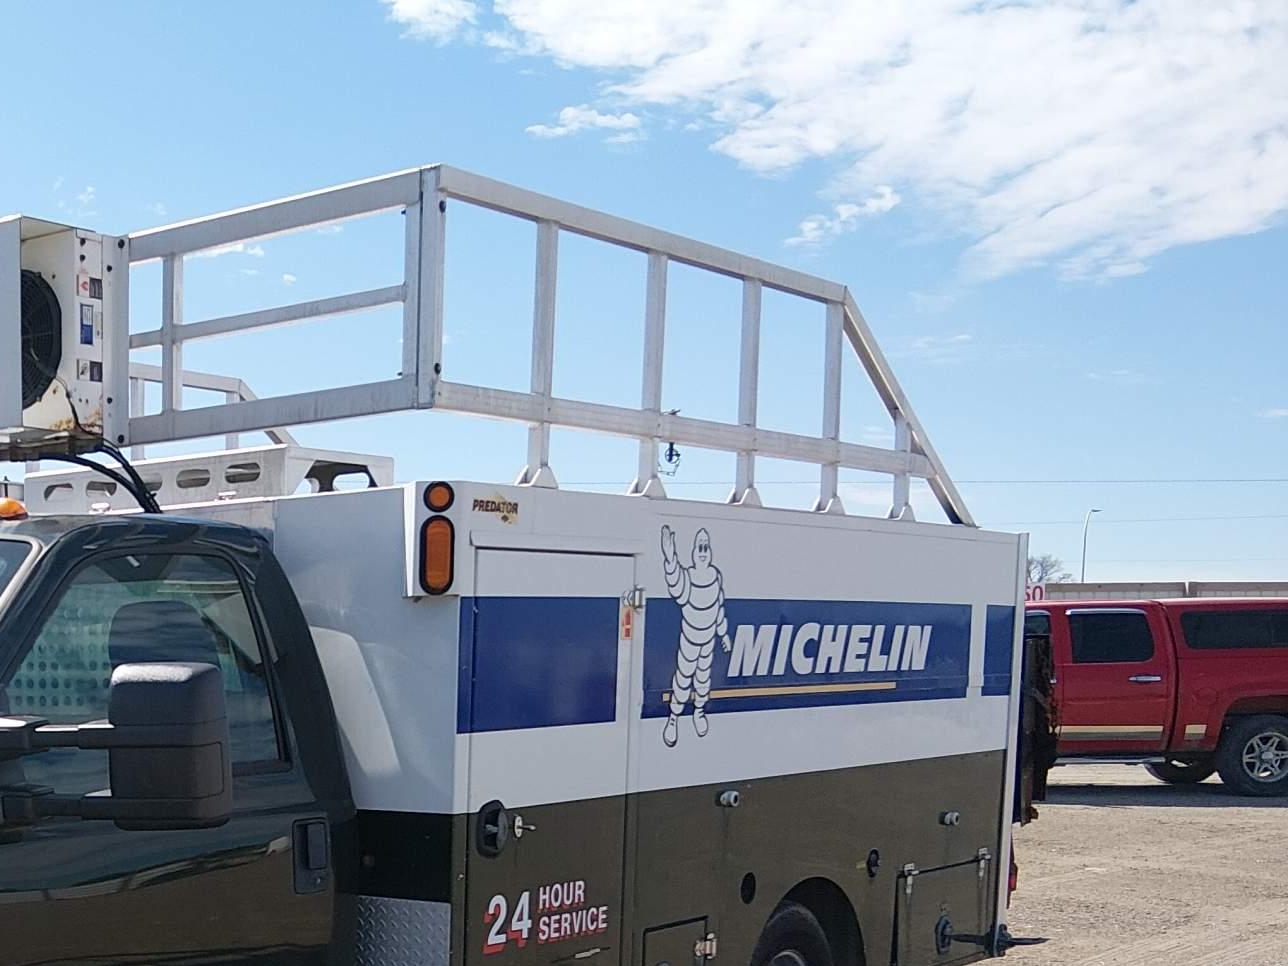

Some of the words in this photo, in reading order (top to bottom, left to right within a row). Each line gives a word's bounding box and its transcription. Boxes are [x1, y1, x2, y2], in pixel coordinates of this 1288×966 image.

[472, 498, 519, 514] PREDATOR
[727, 622, 932, 678] MICHELIN
[538, 880, 585, 911] HOUR
[485, 890, 533, 950] 24
[538, 906, 609, 942] SERVICE
